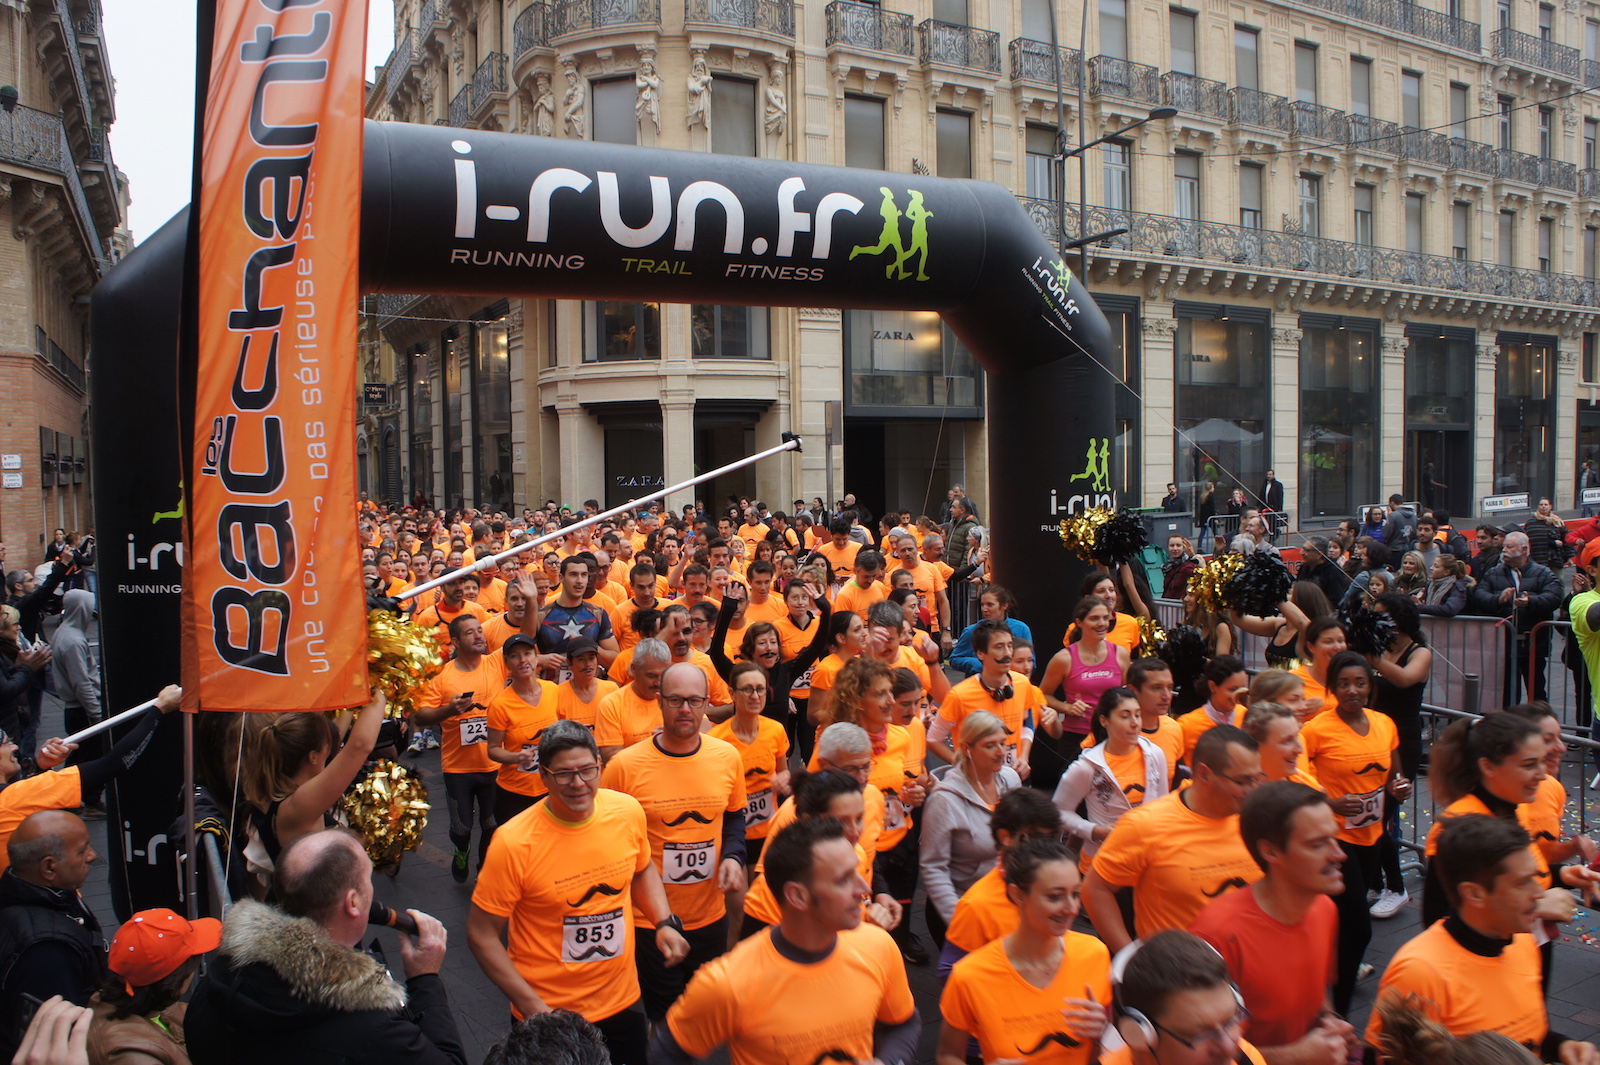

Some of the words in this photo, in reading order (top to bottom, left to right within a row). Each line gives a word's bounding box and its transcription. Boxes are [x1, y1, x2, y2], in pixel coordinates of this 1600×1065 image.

[451, 140, 865, 259] i-run.fr
[450, 248, 586, 271] RUNNING
[621, 257, 693, 275] TRAIL
[725, 263, 825, 281] FITNESS
[1032, 256, 1080, 316] i-run.fr
[1021, 267, 1043, 294] RUNNING
[1042, 292, 1055, 310] TRAIL
[1053, 308, 1072, 332] FITNESS
[211, 0, 332, 677] Bacchant
[294, 258, 322, 405] sérieuse
[873, 330, 915, 341] ZARA
[202, 416, 225, 477] les
[305, 421, 328, 479] pas
[616, 475, 665, 486] ZARA
[118, 584, 183, 594] RUNNING
[304, 620, 330, 674] une
[674, 851, 707, 868] 109
[575, 923, 615, 944] 853
